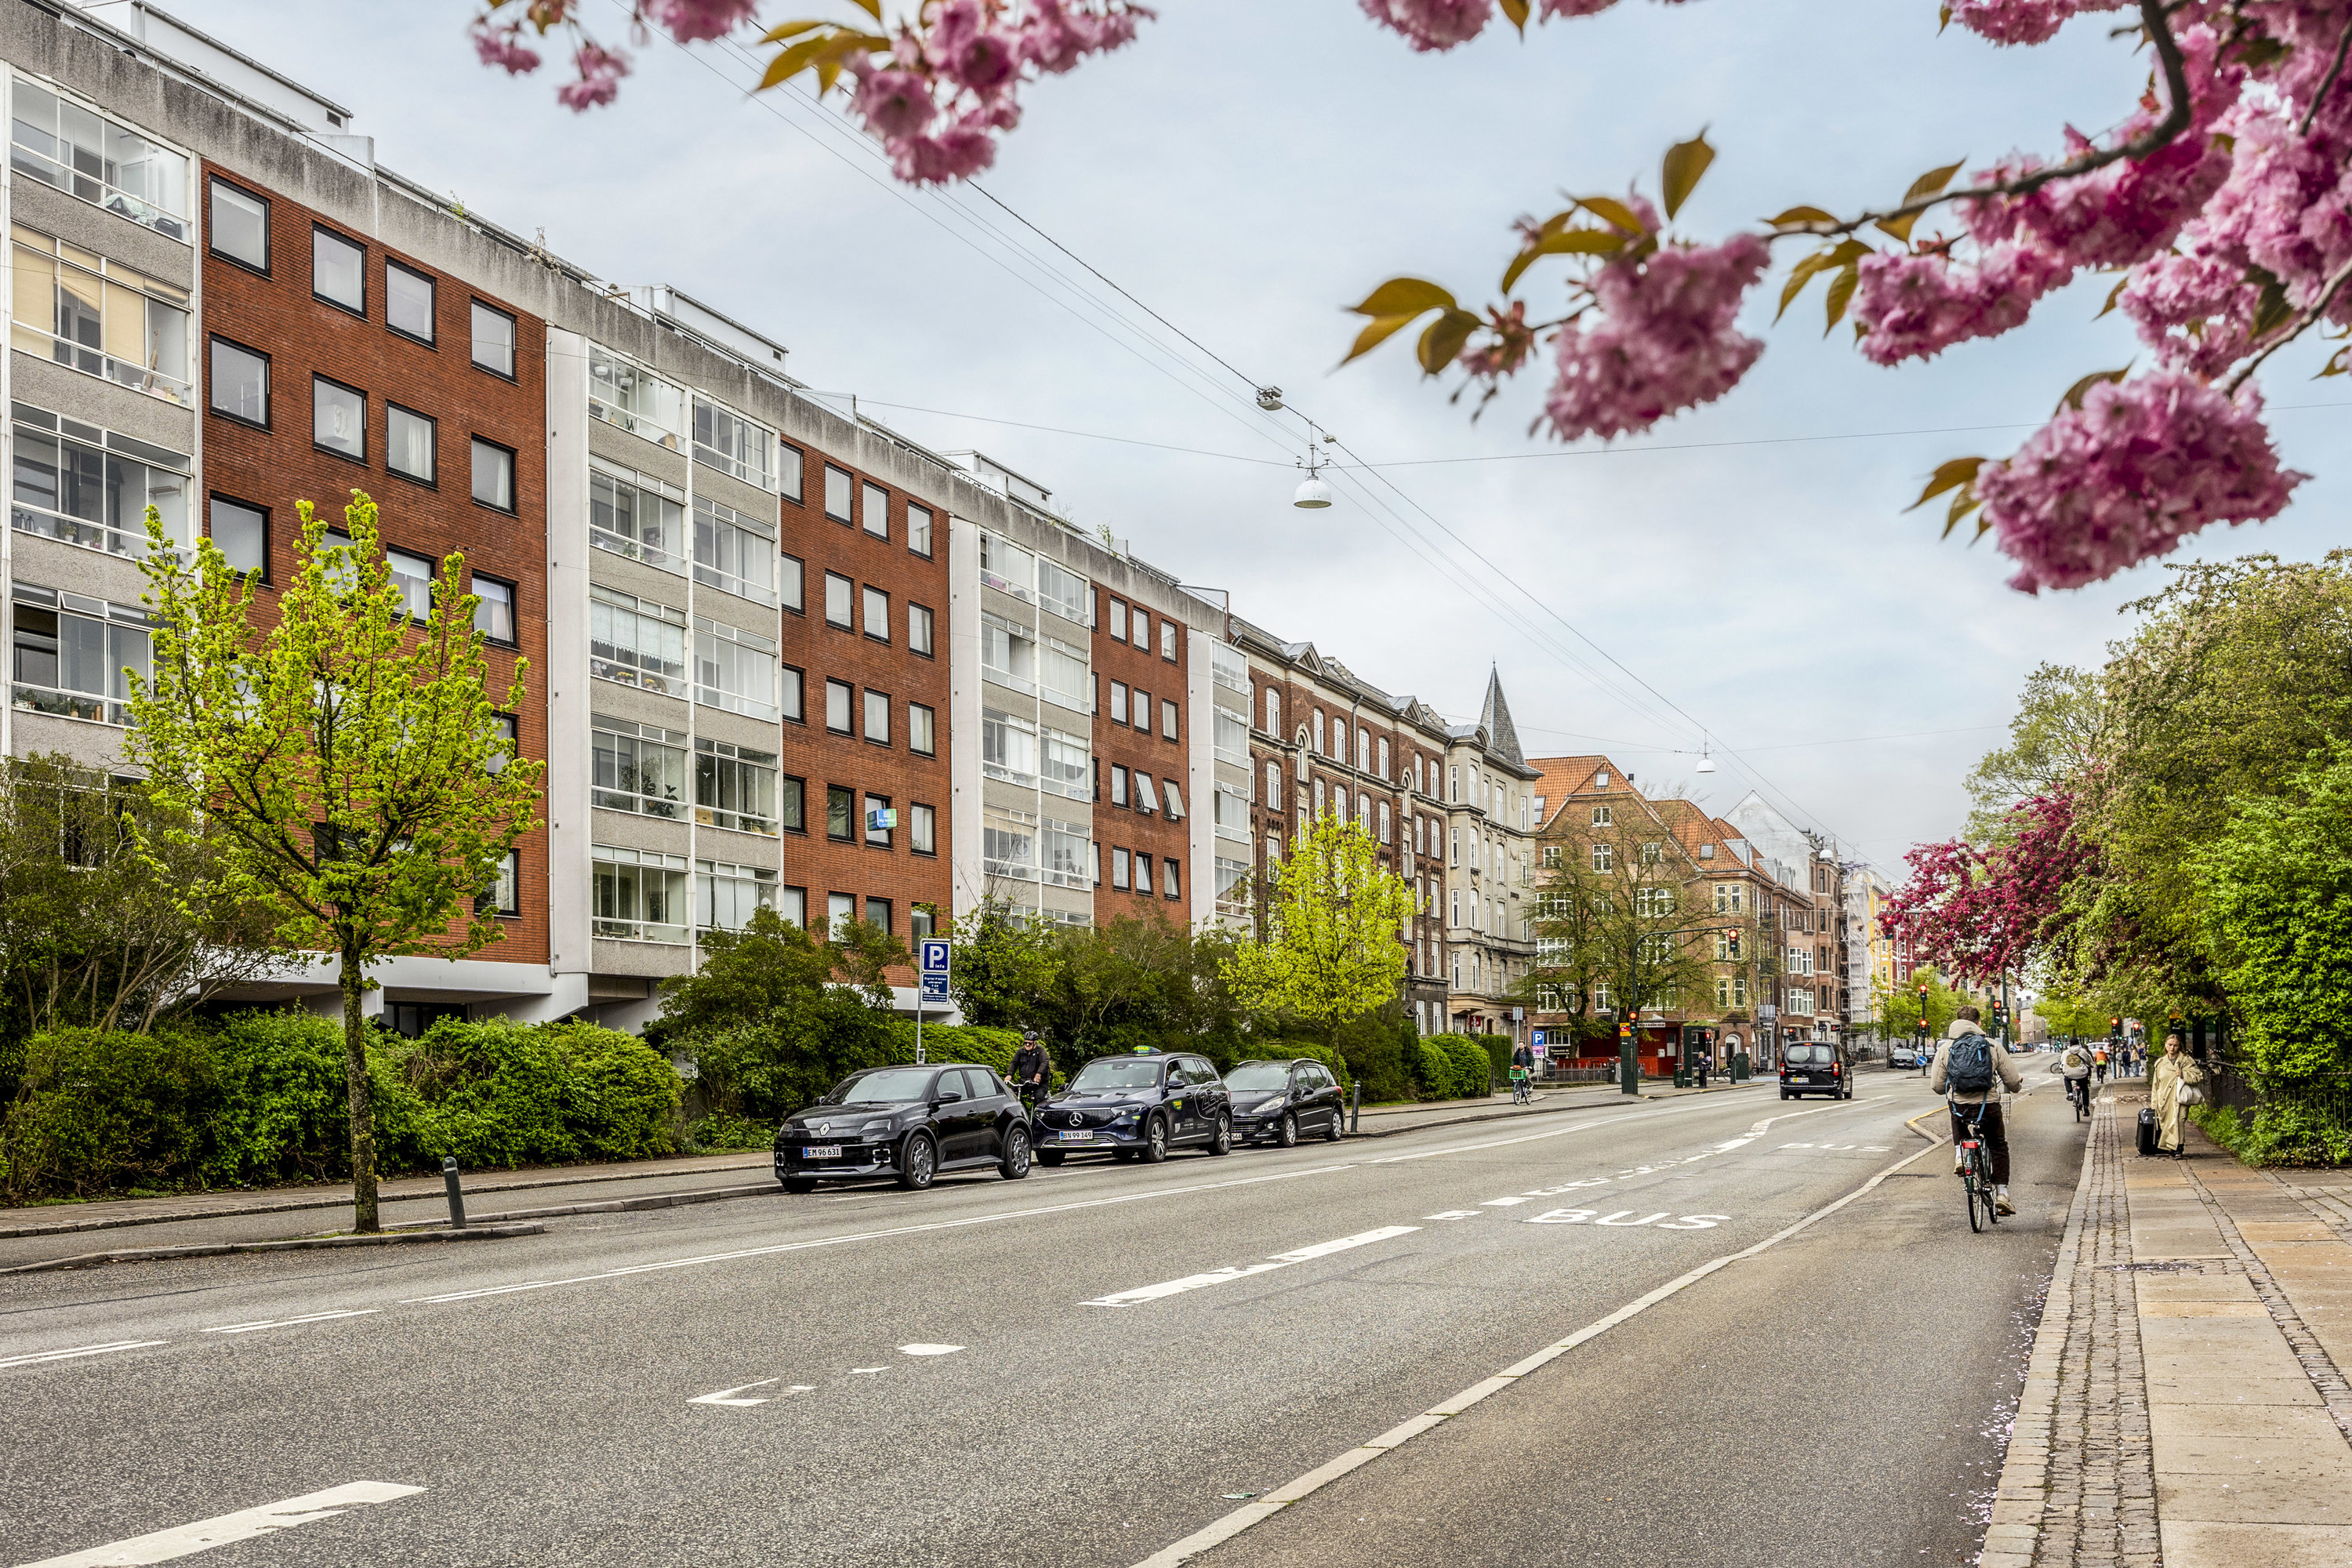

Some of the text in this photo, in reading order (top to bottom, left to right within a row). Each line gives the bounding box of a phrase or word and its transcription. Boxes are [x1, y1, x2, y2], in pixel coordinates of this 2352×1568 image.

[929, 946, 944, 968] P
[1535, 1033, 1542, 1044] P
[1777, 1143, 1893, 1152] BUS
[1523, 1208, 1732, 1229] BUS
